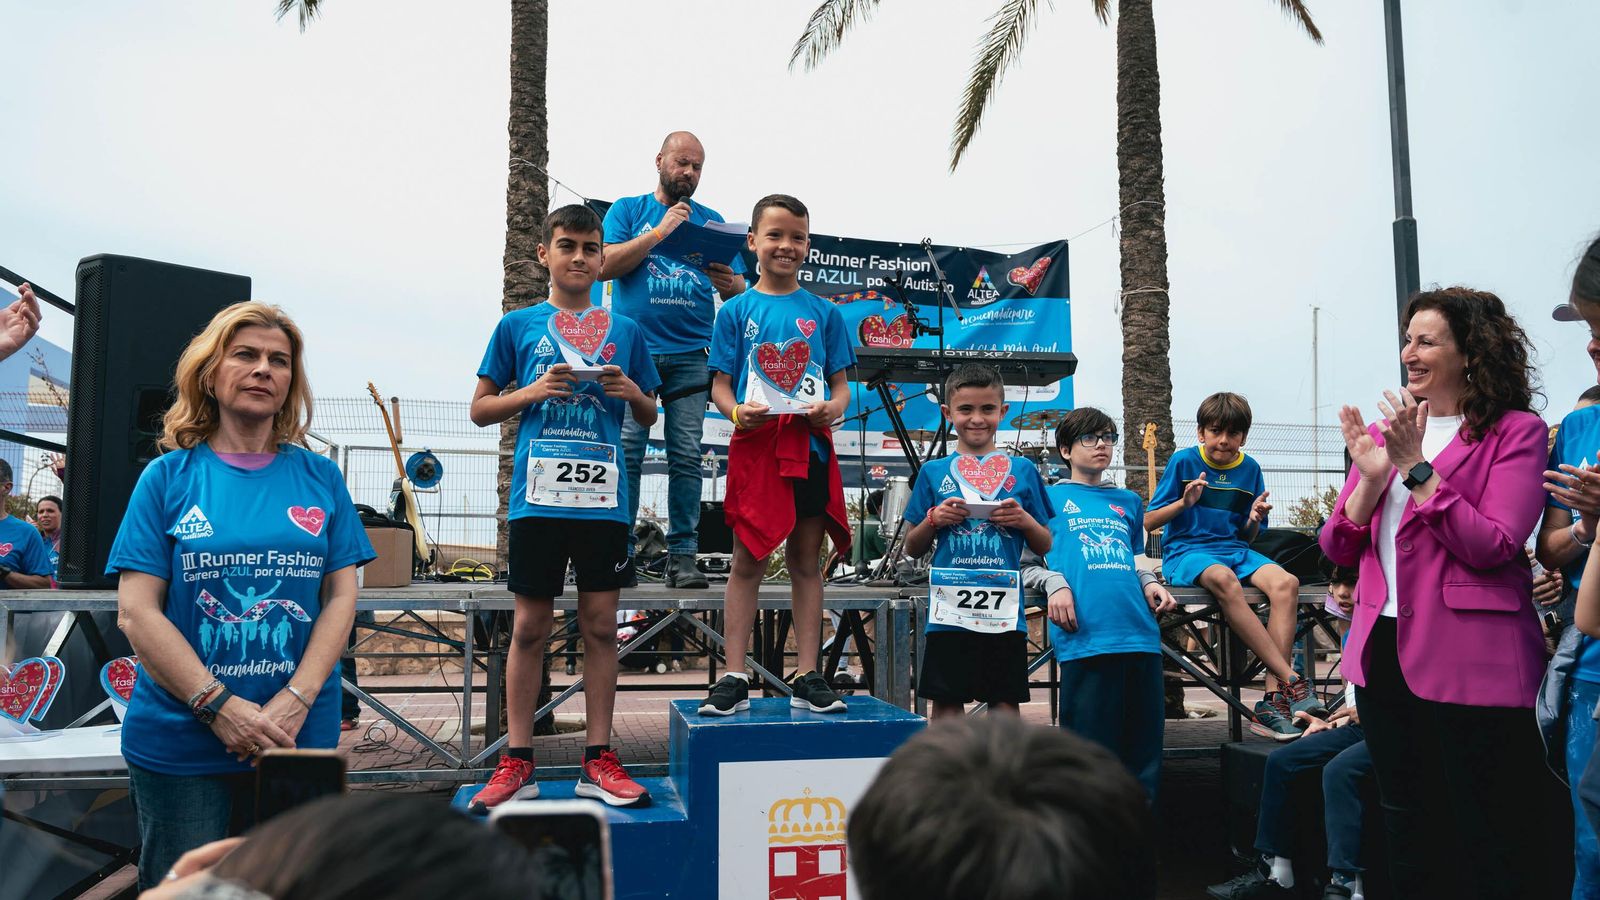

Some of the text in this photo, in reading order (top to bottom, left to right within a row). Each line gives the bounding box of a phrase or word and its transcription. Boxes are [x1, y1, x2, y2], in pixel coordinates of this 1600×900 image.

[808, 248, 930, 273] Runner Fashion
[816, 268, 863, 286] AZUL
[904, 277, 954, 293] Autiso
[967, 288, 1000, 299] ALTEA
[984, 350, 1013, 358] XF7
[556, 462, 607, 483] 252
[173, 521, 213, 536] ALTEA
[181, 550, 324, 571] III Runner Fashion
[183, 566, 321, 582] Carrera AZUL por el Autismo
[957, 589, 1007, 610] 227
